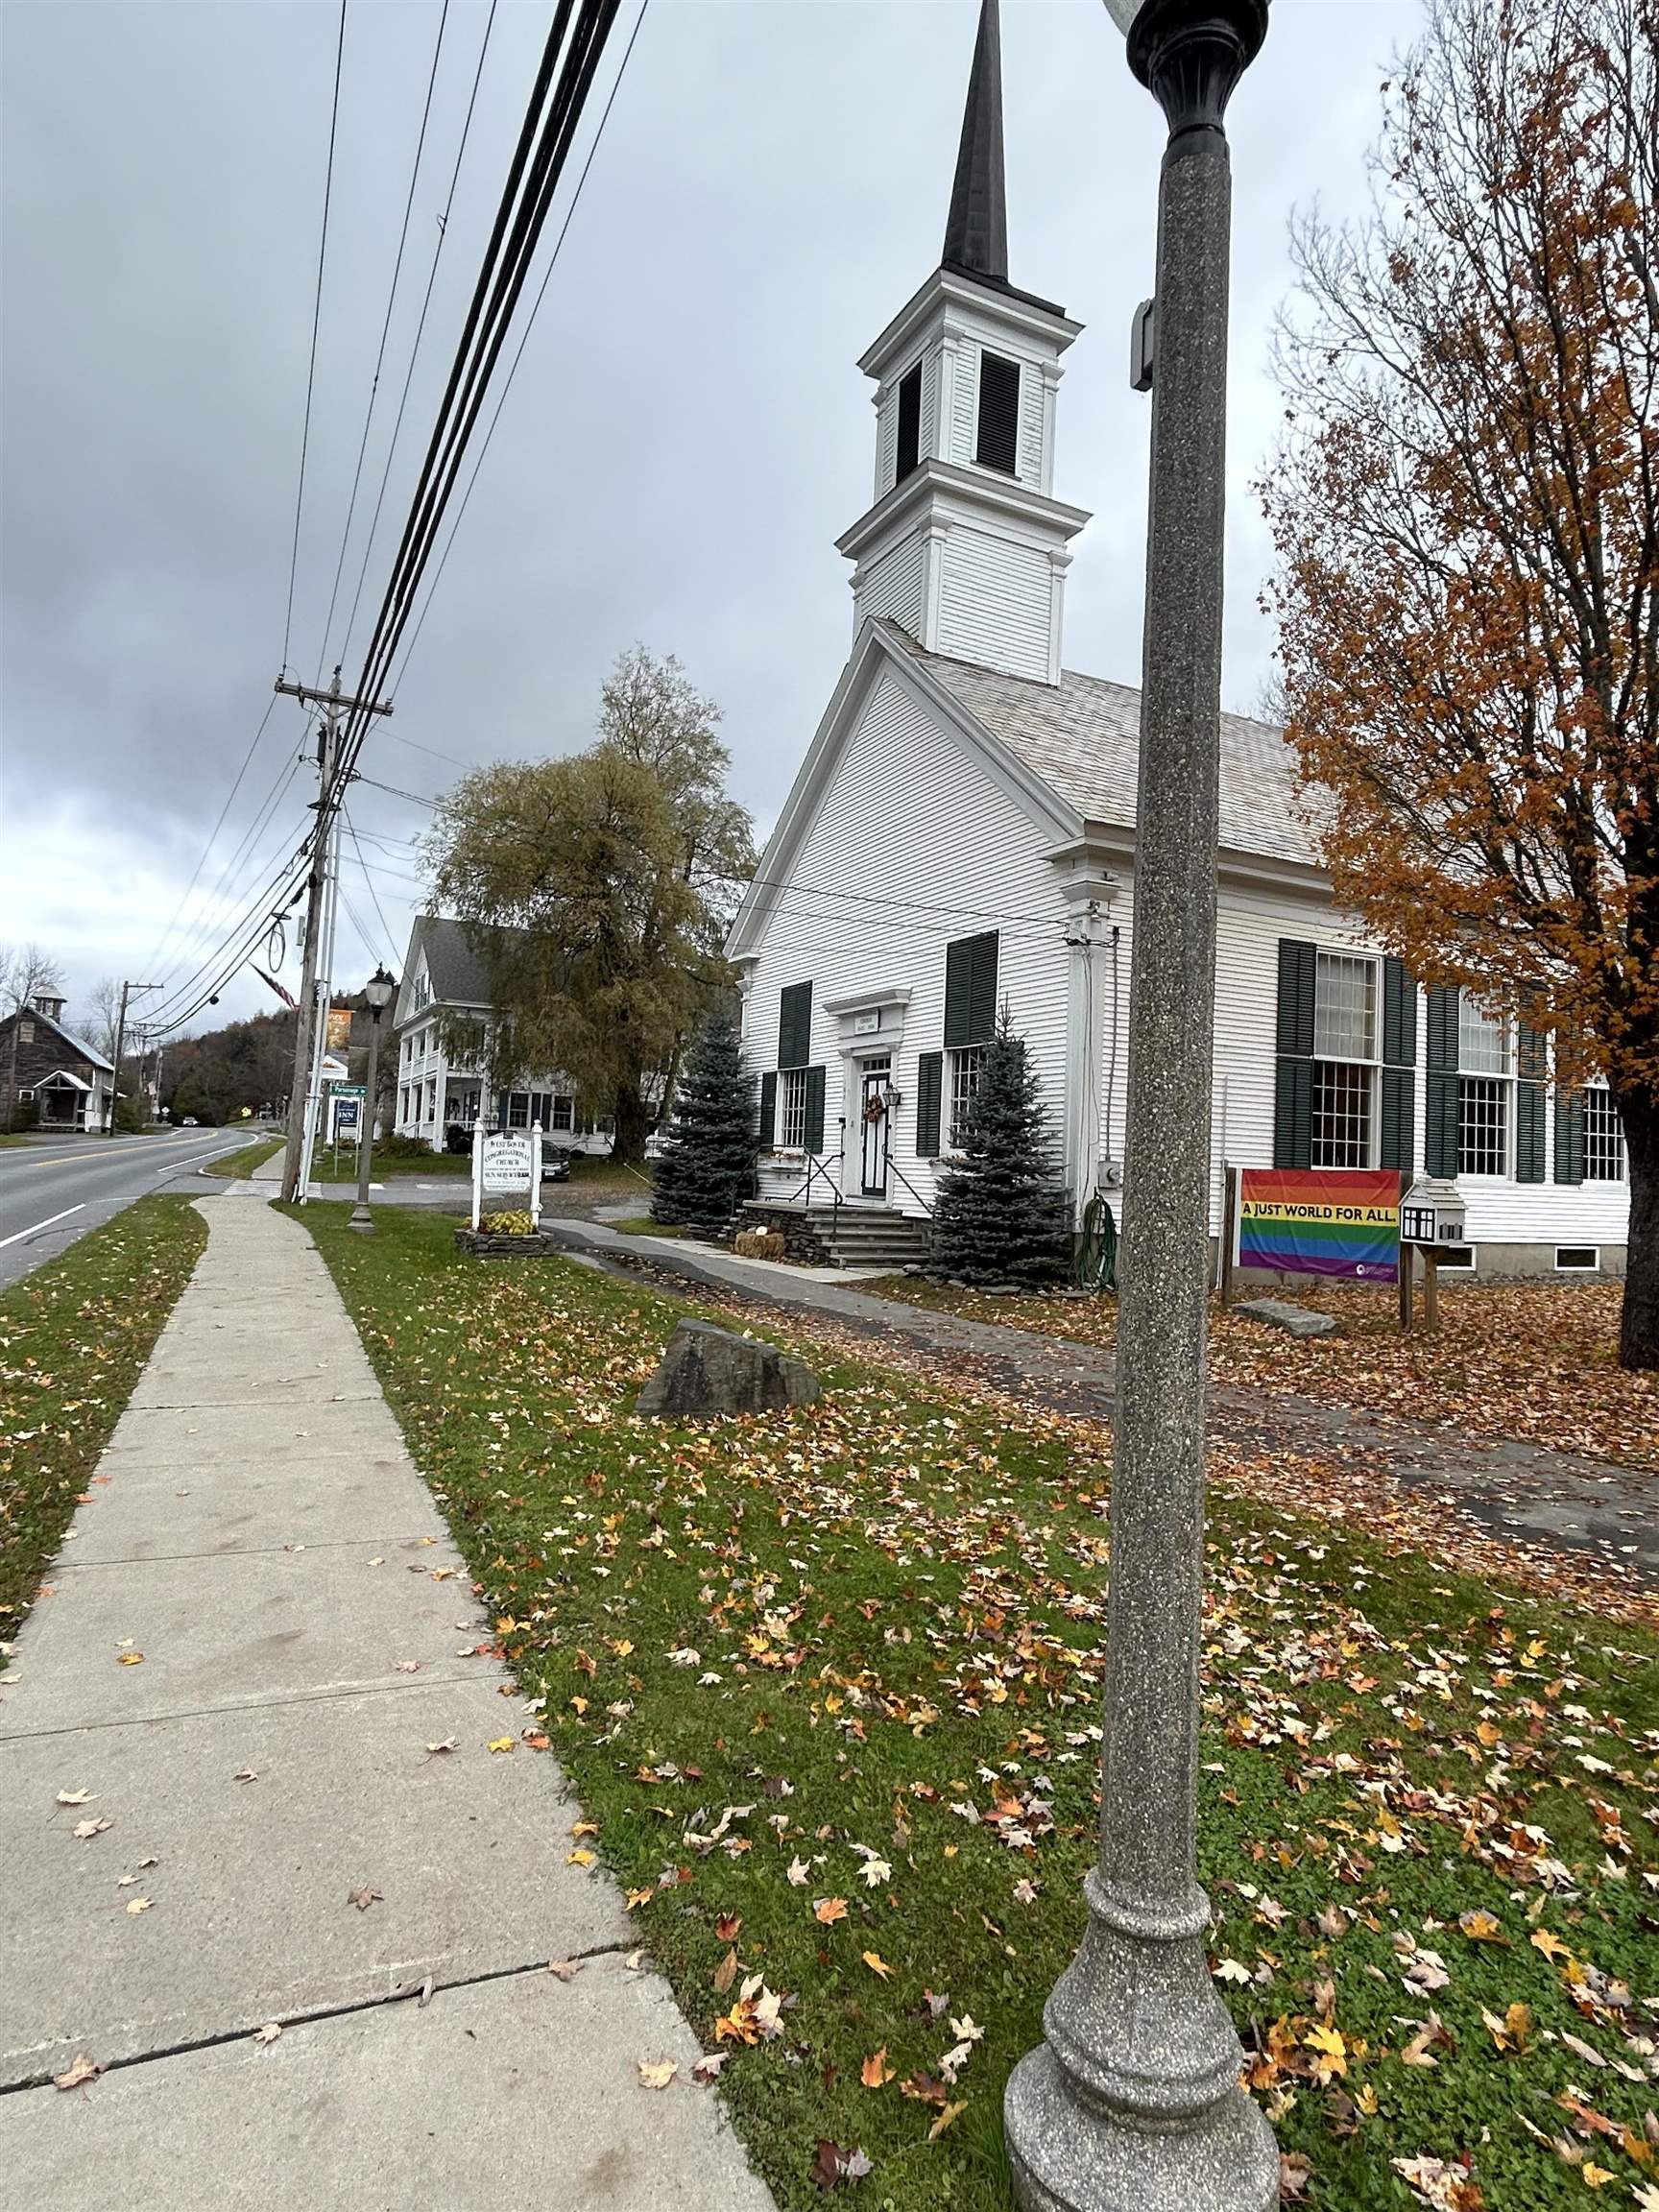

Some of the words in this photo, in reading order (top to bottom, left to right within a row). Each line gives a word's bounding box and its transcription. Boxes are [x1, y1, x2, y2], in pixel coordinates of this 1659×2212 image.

[485, 1149, 530, 1162] CONGREGATIONAL
[1243, 1203, 1251, 1214] A
[1254, 1204, 1283, 1217] JUST
[1285, 1205, 1333, 1219] WORLD
[1335, 1207, 1363, 1221] FOR
[1366, 1209, 1397, 1222] ALL.
